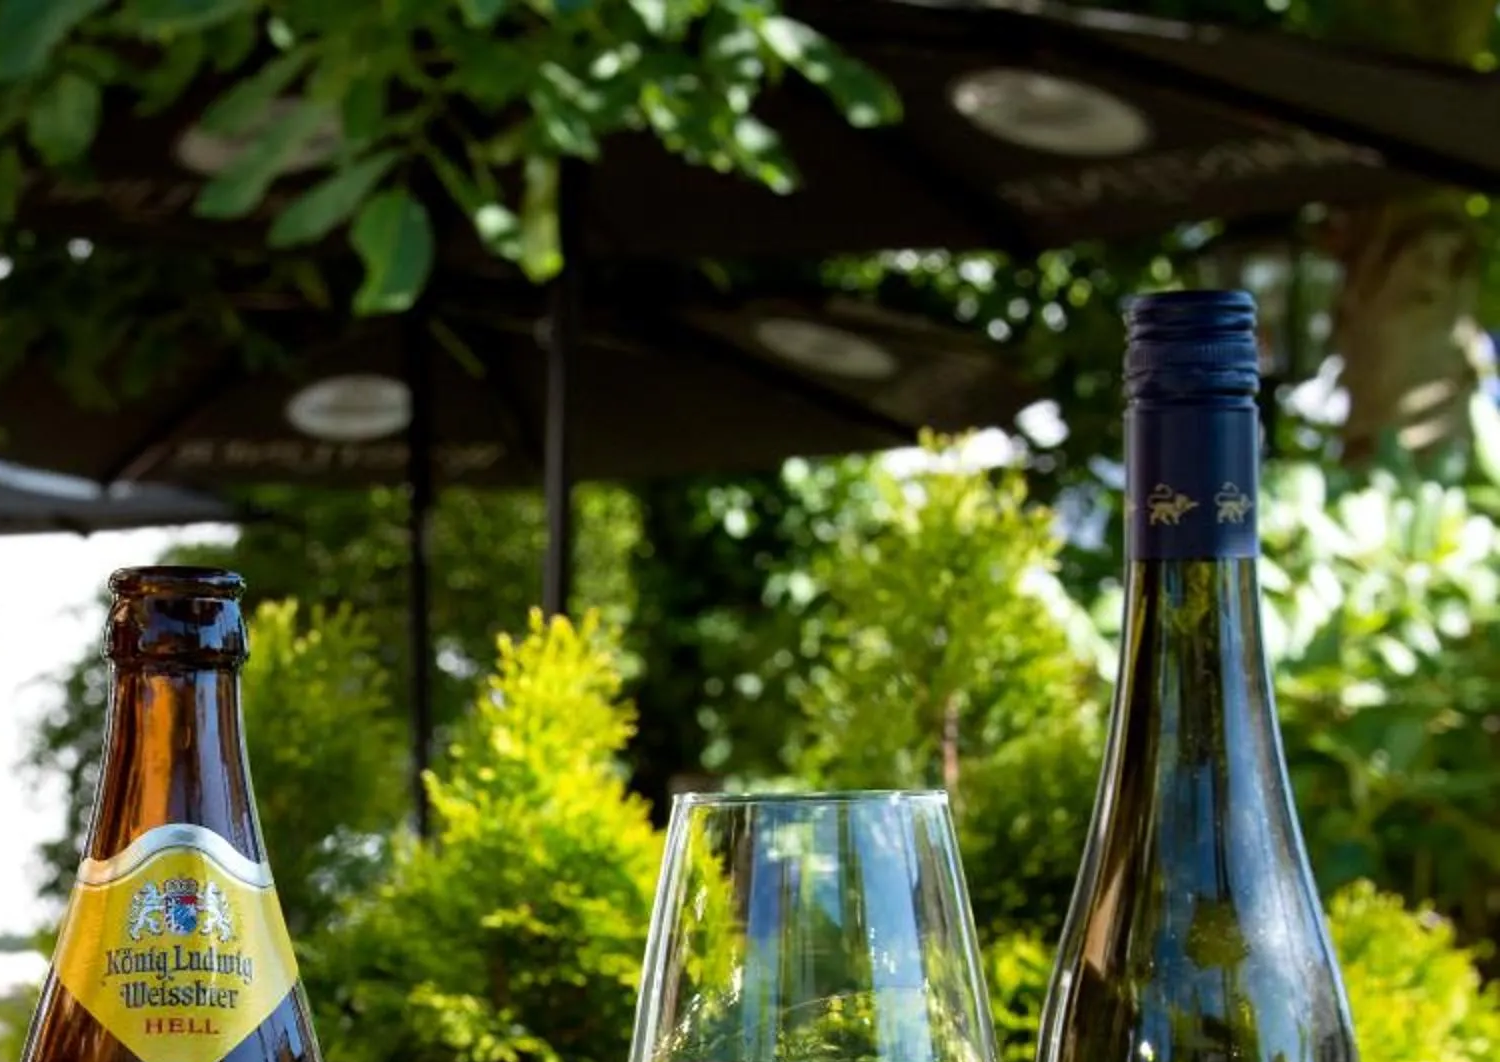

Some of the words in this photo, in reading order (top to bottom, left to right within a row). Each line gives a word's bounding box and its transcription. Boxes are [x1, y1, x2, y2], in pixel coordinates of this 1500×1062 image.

[102, 945, 168, 985] König
[168, 944, 255, 986] Ludwig
[120, 980, 240, 1009] Weissbier
[144, 1017, 220, 1035] HELL
